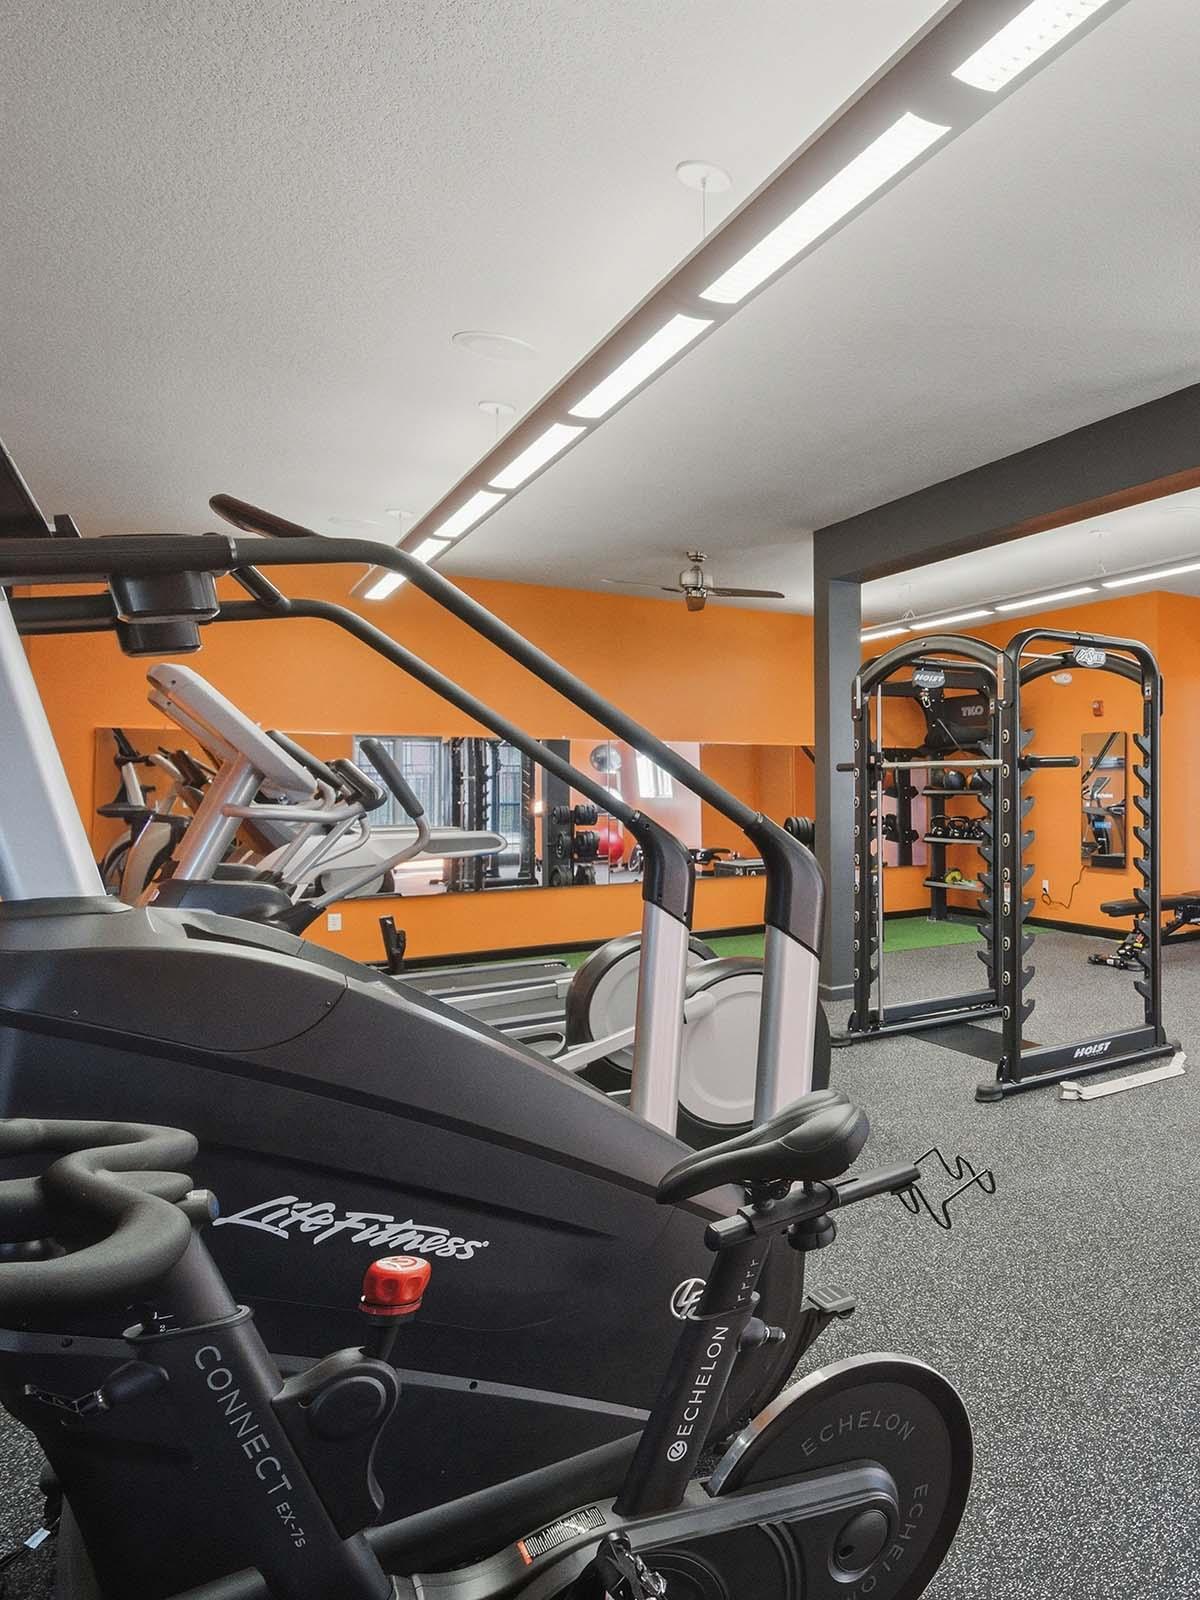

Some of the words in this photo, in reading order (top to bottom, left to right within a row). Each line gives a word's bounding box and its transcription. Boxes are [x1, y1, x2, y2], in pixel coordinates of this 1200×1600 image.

[914, 673, 945, 682] HOIST
[961, 705, 984, 717] TKO
[1073, 1041, 1112, 1058] HOIST
[676, 1326, 729, 1436] ECHELON
[195, 1345, 293, 1495] CONNECT
[801, 1410, 915, 1457] ECHELON
